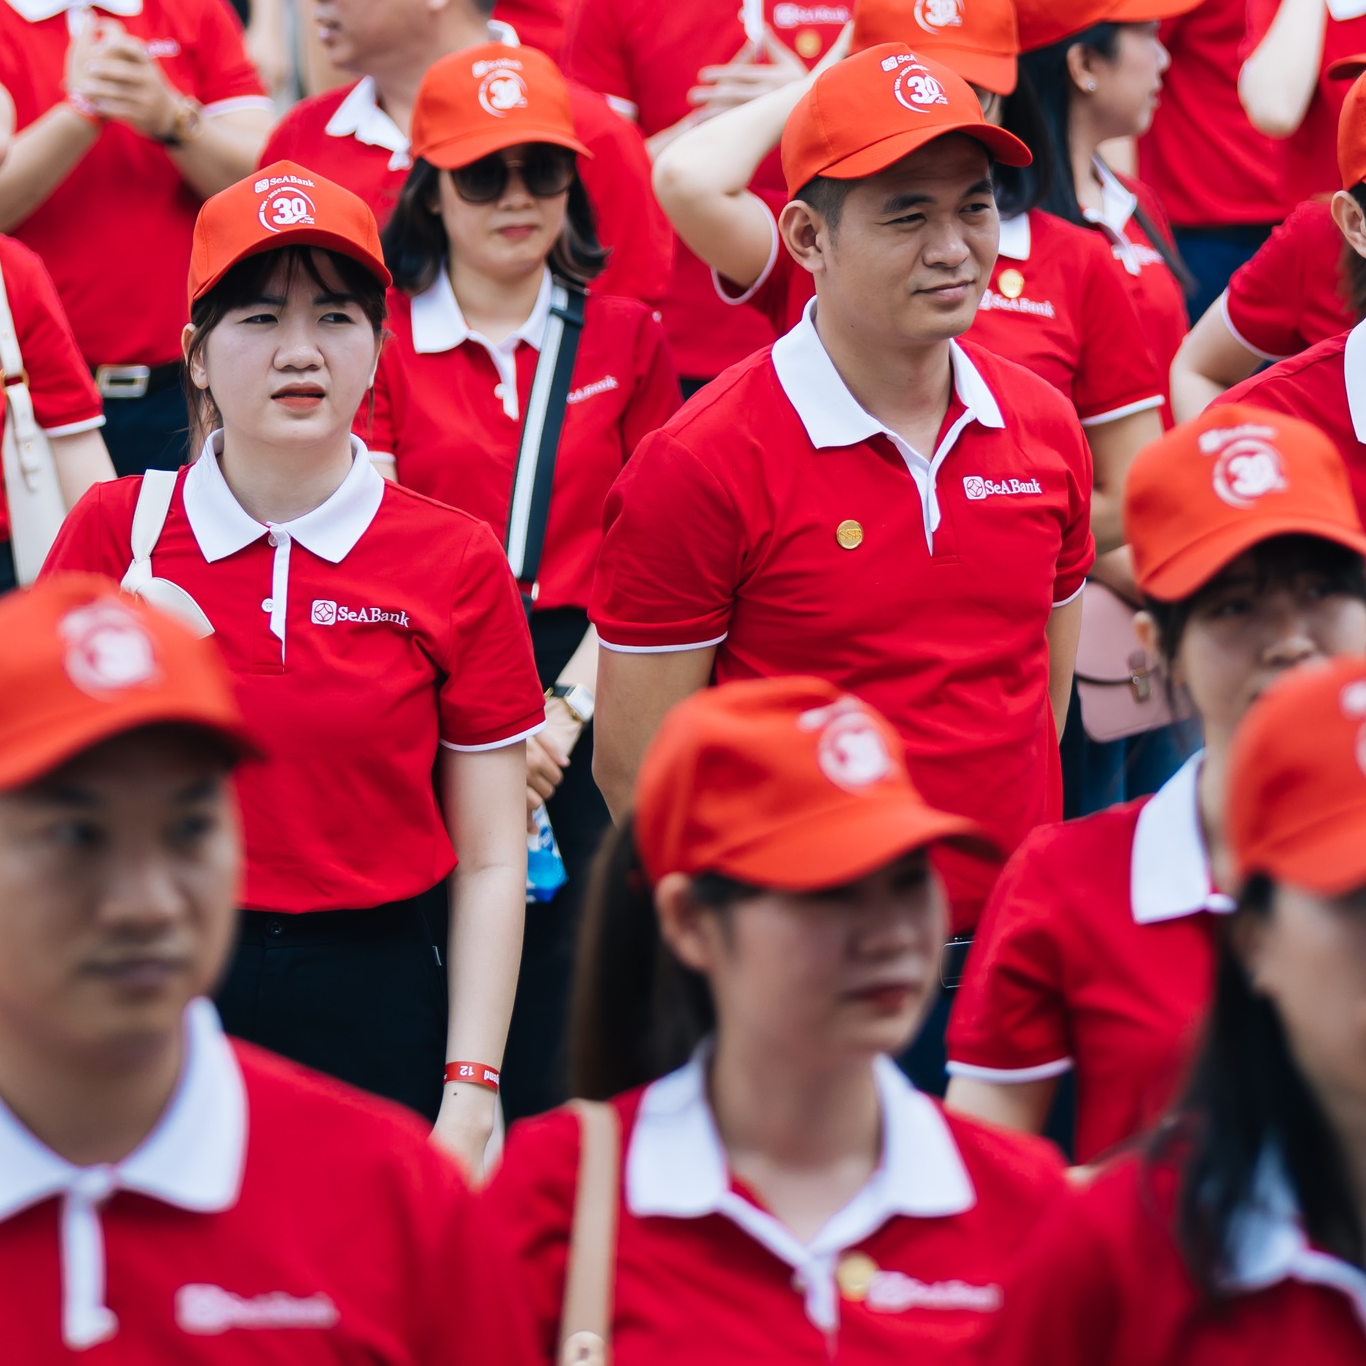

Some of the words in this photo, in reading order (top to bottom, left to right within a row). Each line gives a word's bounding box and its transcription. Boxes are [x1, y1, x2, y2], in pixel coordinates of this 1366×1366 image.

[907, 75, 941, 104] 30
[269, 175, 315, 188] SeABank
[272, 197, 310, 225] 30
[985, 477, 1041, 496] SeABank
[337, 605, 409, 628] SeABank
[459, 1065, 476, 1077] 12
